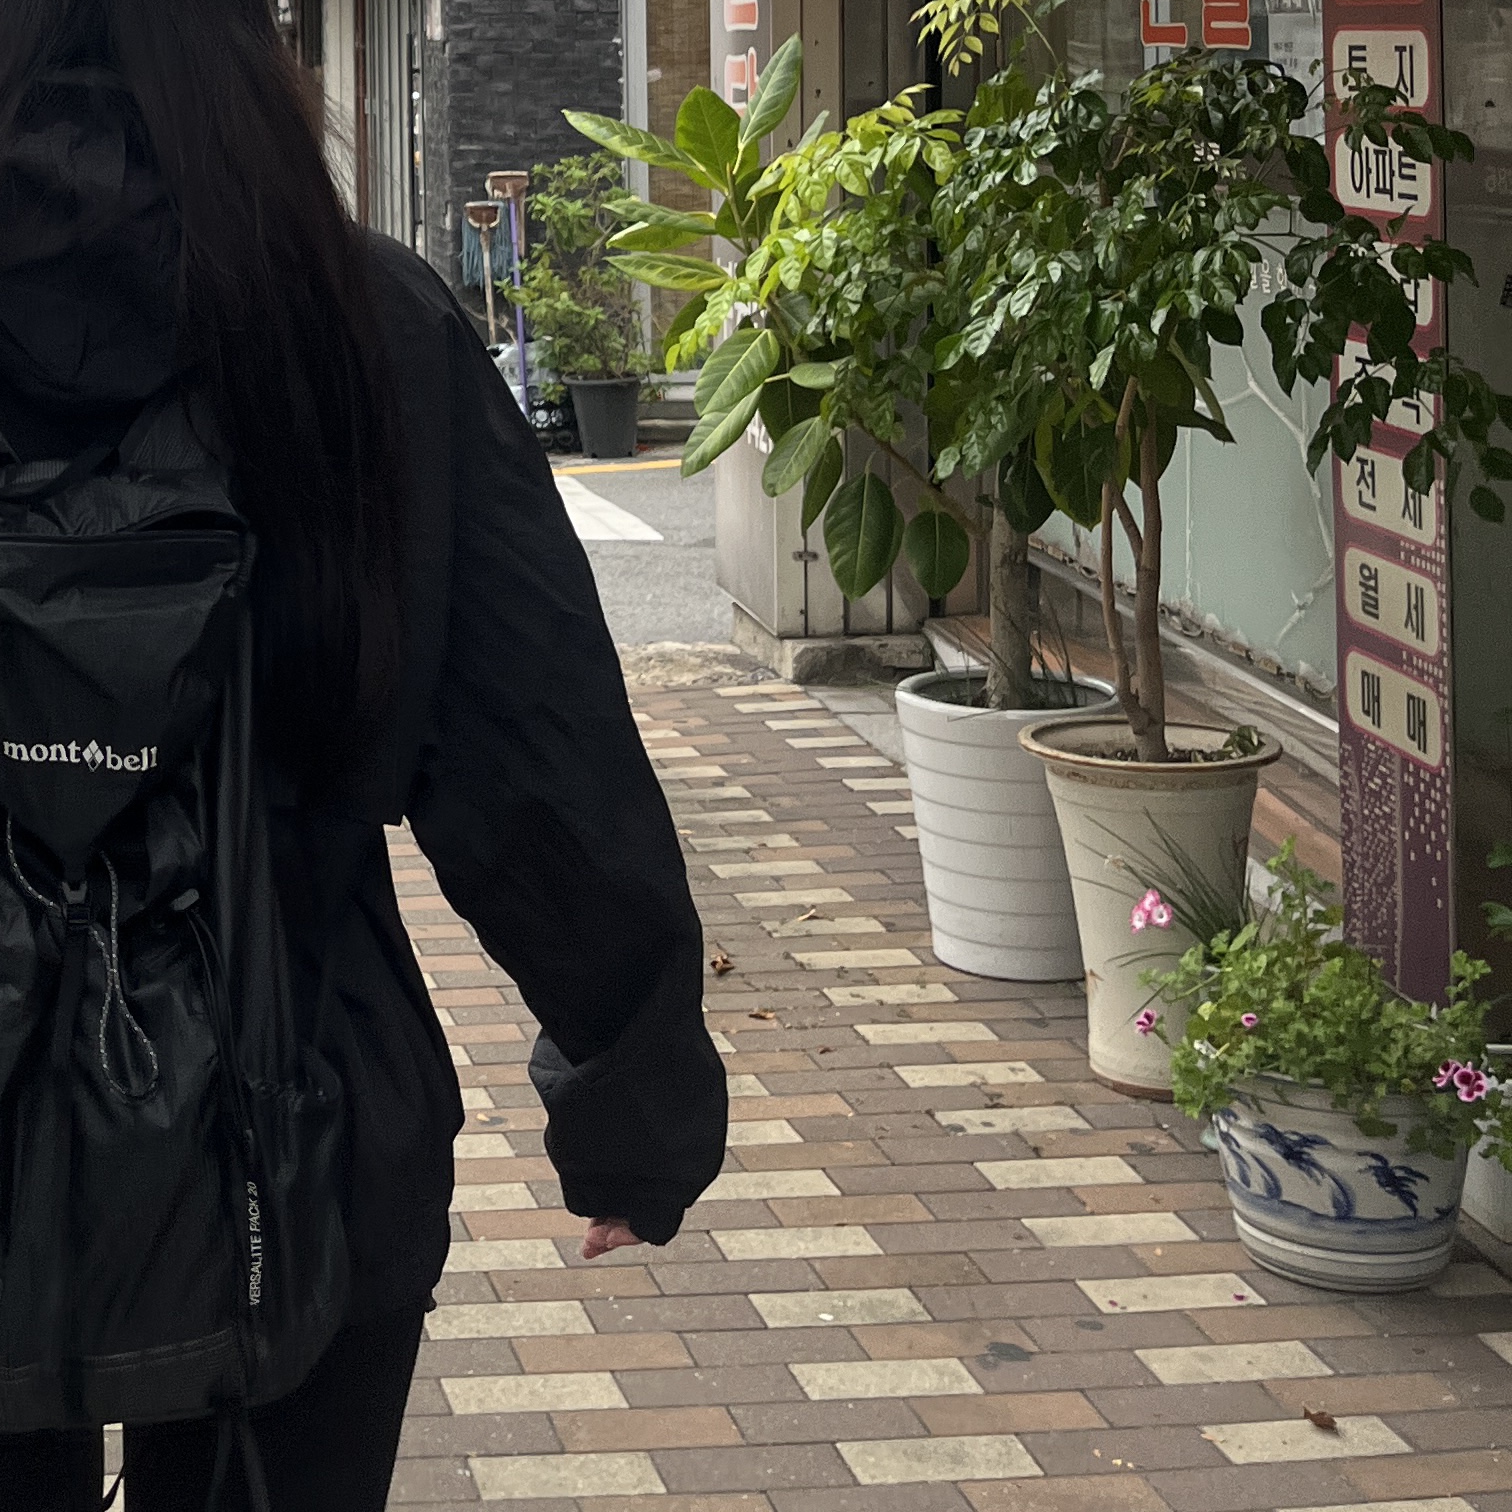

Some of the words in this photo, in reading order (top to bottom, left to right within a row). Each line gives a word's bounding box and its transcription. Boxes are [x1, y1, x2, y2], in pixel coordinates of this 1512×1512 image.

[1349, 145, 1419, 202] 아파트
[1359, 562, 1426, 643] 월세
[1361, 669, 1429, 755] 매매
[248, 1234, 263, 1306] VERSALITE
